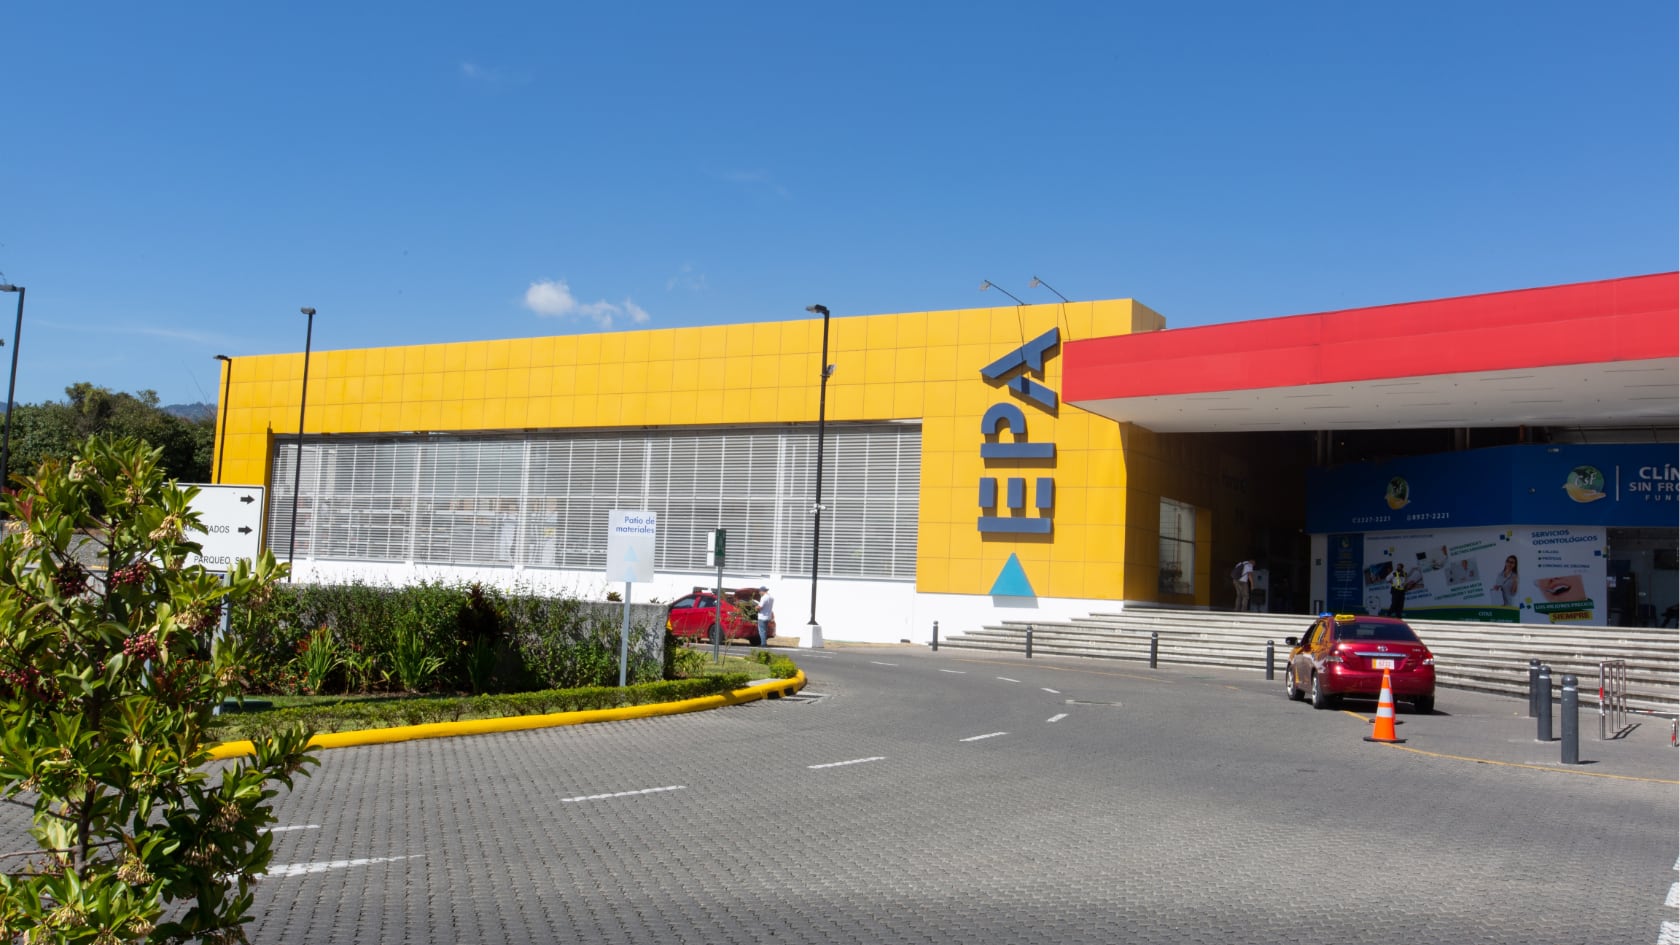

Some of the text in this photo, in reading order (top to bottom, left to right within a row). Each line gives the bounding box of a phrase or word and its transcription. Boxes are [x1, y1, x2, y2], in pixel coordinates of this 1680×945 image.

[977, 326, 1060, 535] EPA
[1629, 482, 1652, 492] SIN
[1645, 494, 1679, 502] FUN
[624, 516, 655, 525] Patio de
[615, 525, 655, 534] materiales
[1531, 529, 1570, 538] SERVICIOS
[1532, 535, 1598, 546] ODONTOLÓGICOS
[194, 555, 231, 565] PARQUEO
[1552, 611, 1590, 620] SIEMPRE
